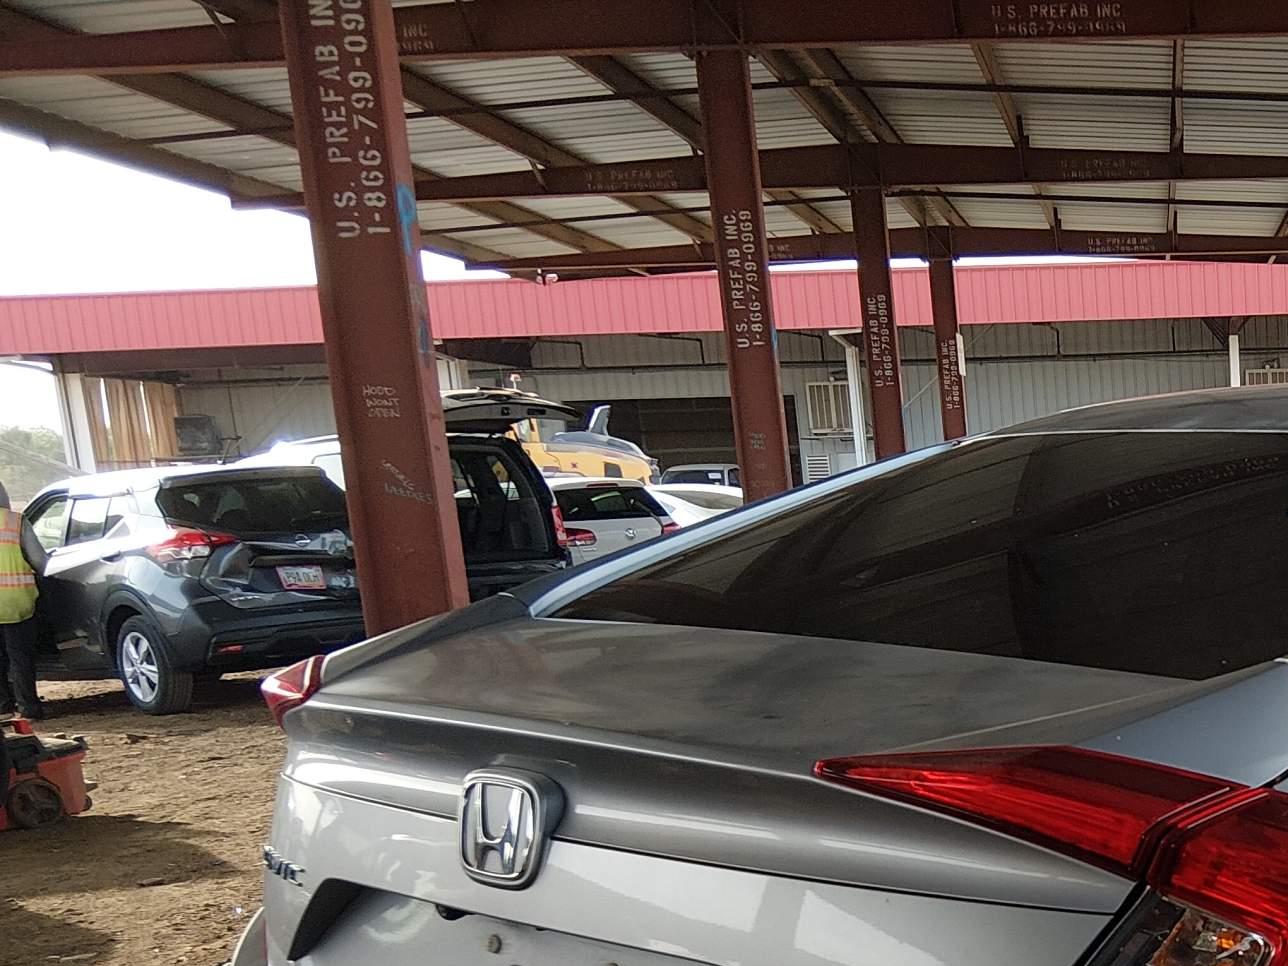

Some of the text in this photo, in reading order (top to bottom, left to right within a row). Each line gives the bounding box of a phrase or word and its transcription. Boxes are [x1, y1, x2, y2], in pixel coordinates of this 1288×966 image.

[1029, 3, 1089, 19] PREFAB
[314, 44, 352, 163] PREFAB
[333, 181, 360, 238] U.S.
[723, 209, 750, 348] U.S. PREFAB INC.
[739, 210, 765, 345] 1-866-799-0969
[869, 320, 882, 361] PREFAB
[942, 358, 951, 390] PREFAB
